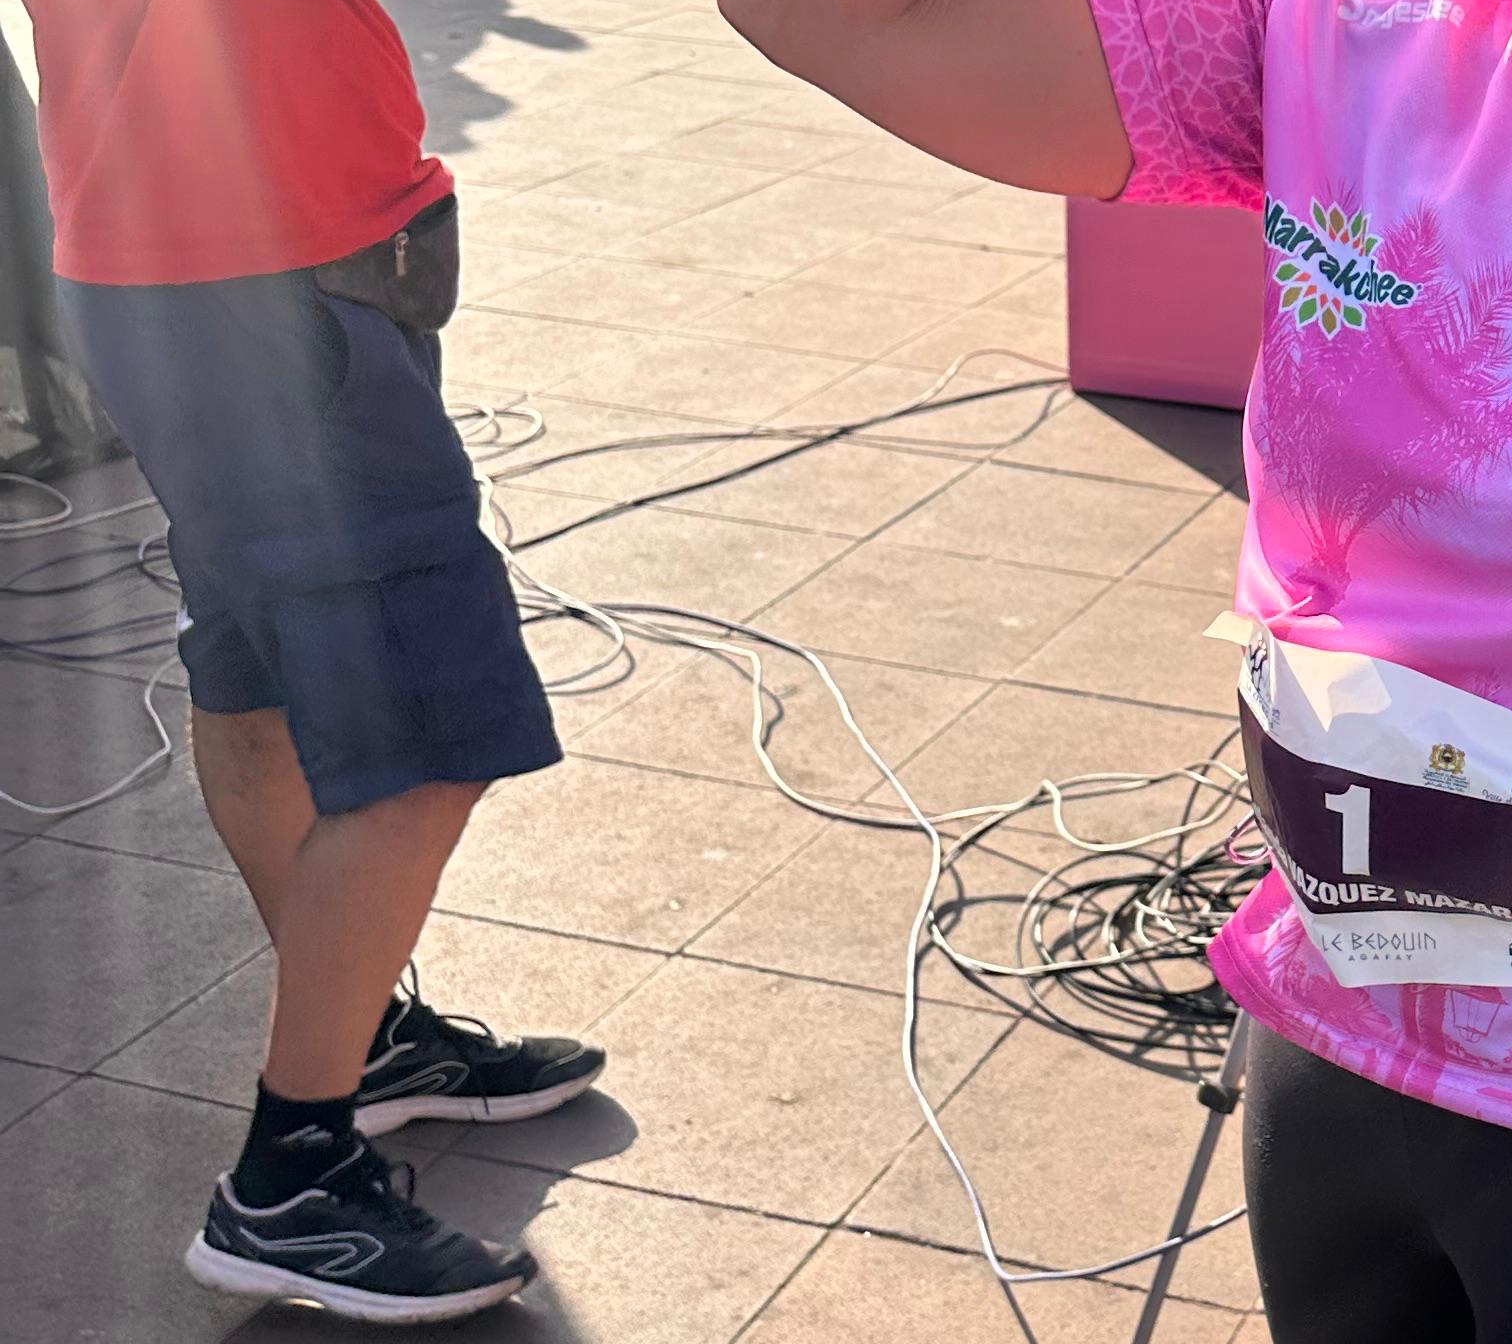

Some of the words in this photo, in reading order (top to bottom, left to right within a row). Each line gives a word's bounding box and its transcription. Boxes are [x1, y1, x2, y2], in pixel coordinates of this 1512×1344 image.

[1264, 195, 1415, 306] Marrakchee
[1325, 784, 1371, 876] 1
[1321, 933, 1343, 953] LE
[1351, 932, 1437, 953] BEDOUIN
